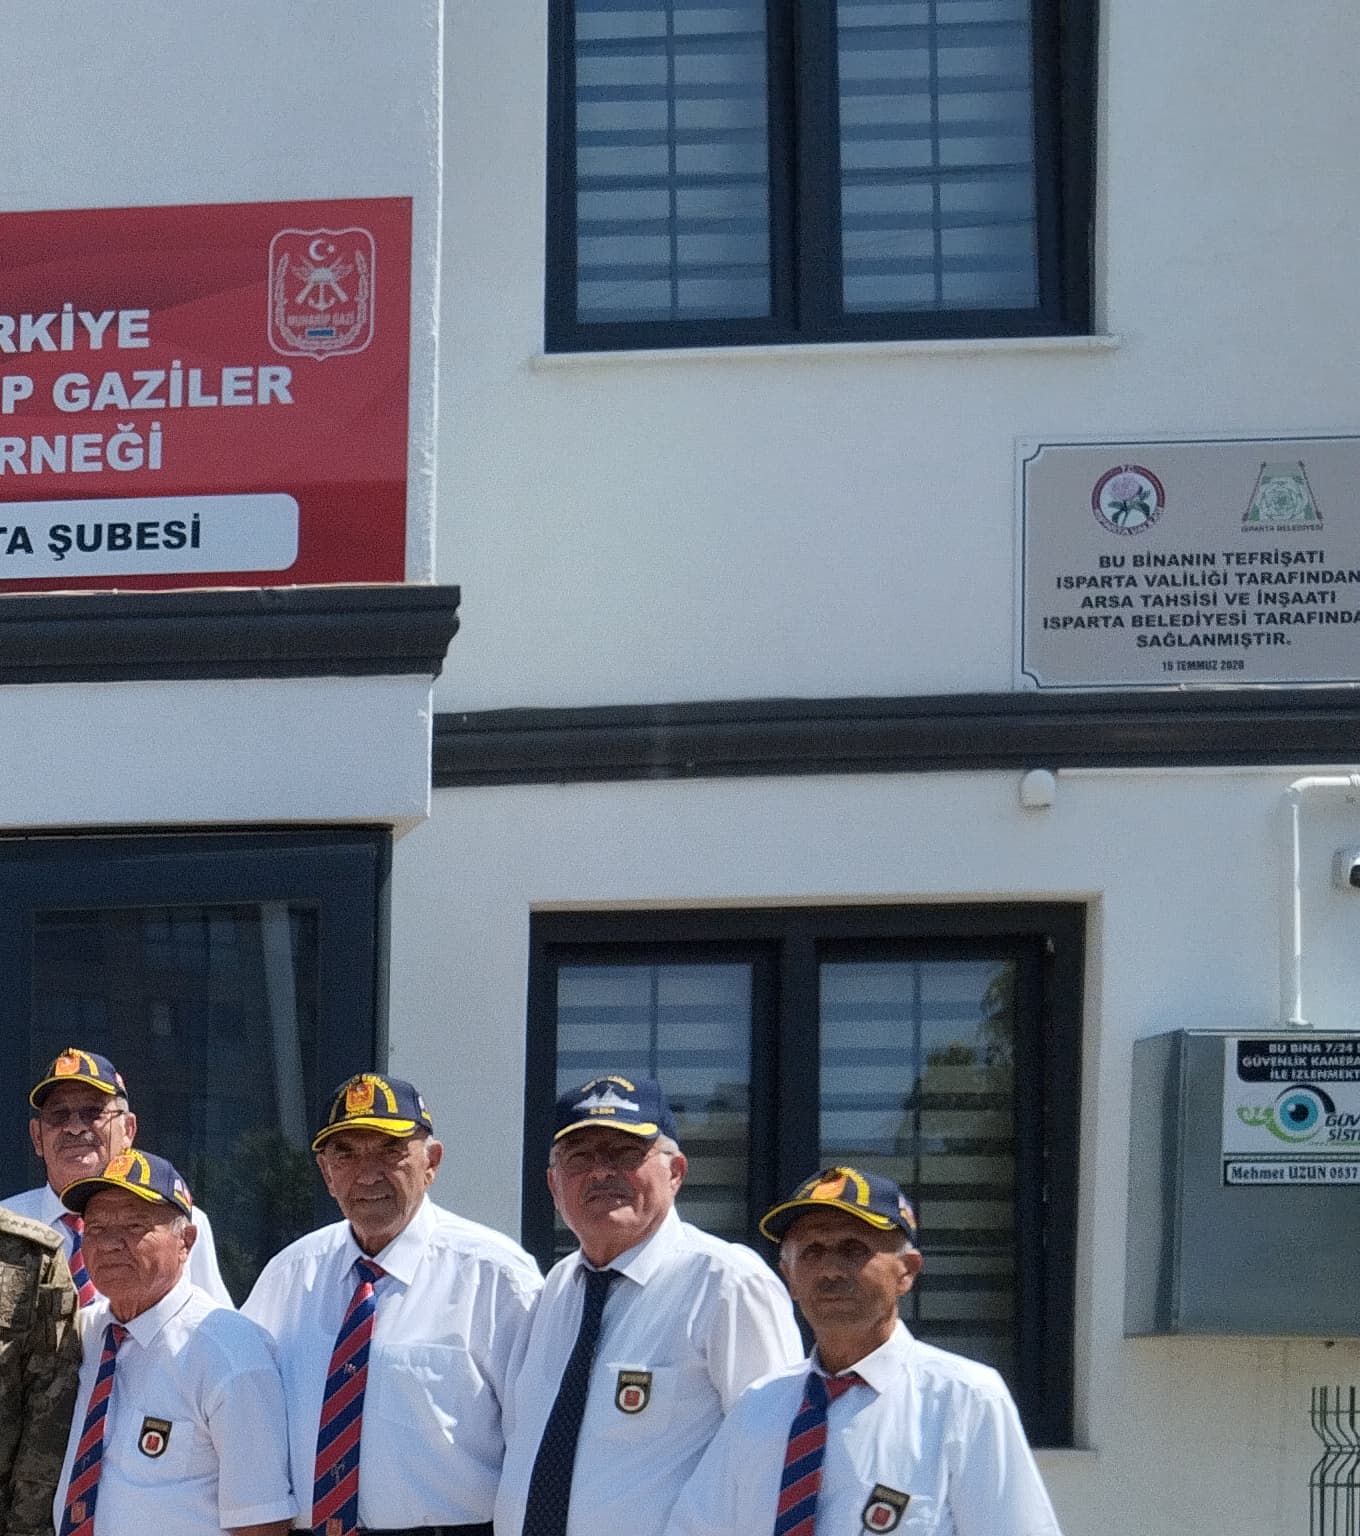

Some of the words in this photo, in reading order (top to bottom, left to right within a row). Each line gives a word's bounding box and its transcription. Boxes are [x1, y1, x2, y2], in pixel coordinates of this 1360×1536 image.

[53, 360, 294, 412] GAZİLER
[48, 513, 200, 561] ŞUBESİ
[1099, 555, 1125, 568] BU
[1133, 551, 1215, 568] BİNANIN
[1222, 548, 1325, 568] TEFRİŞATI
[1056, 575, 1138, 589] ISPARTA
[1144, 570, 1228, 587] VALİLİĞİ
[1235, 570, 1360, 586] TARAFINDAN
[1081, 595, 1133, 608] ARSA
[1140, 590, 1217, 607] TAHSİSİ
[1225, 592, 1250, 606] VE
[1258, 589, 1336, 608] İNŞAATI
[1043, 616, 1124, 629] ISPARTA
[1131, 610, 1247, 627] BELEDİYESİ
[1136, 631, 1292, 650] SAĞLANMIŞTIR.
[1268, 1043, 1286, 1053] BU
